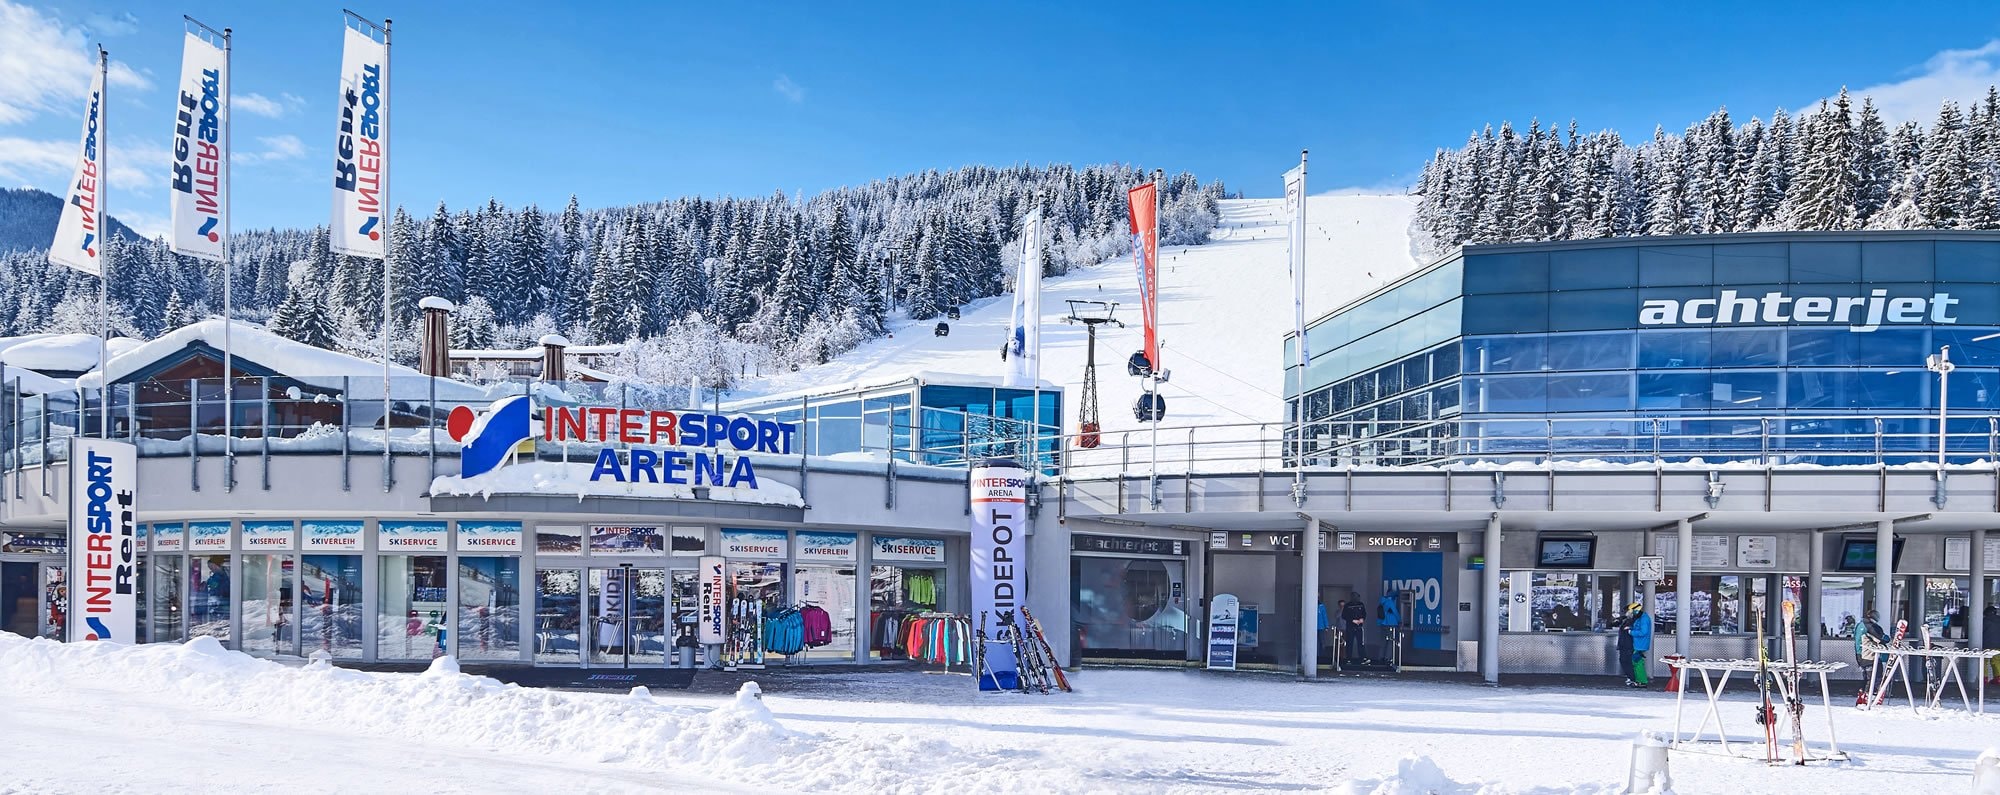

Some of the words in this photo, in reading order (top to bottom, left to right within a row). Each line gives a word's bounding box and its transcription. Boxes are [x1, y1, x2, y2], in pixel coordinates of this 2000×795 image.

[1639, 289, 1959, 333] achterjet
[545, 406, 796, 454] INTERSPORT
[590, 448, 758, 489] ARENA
[988, 489, 1013, 497] ARENA
[87, 450, 113, 613] INTERSPORT
[606, 527, 657, 535] INTERSPORT
[116, 489, 133, 595] Rent
[249, 537, 287, 545] SKISERVICE
[389, 538, 438, 546] SKISERVICE
[467, 538, 516, 546] SKISERVICE
[1269, 535, 1290, 546] WC
[1368, 537, 1384, 546] SKI
[1386, 537, 1418, 546] DEPOT
[729, 545, 779, 554] SKISERVICE
[804, 547, 849, 556] SKIVERLEIH
[881, 544, 936, 555] SKISERVICE
[992, 508, 1014, 644] SKIDEPOT
[703, 582, 713, 623] Rent
[712, 578, 722, 636] INTERSPORT
